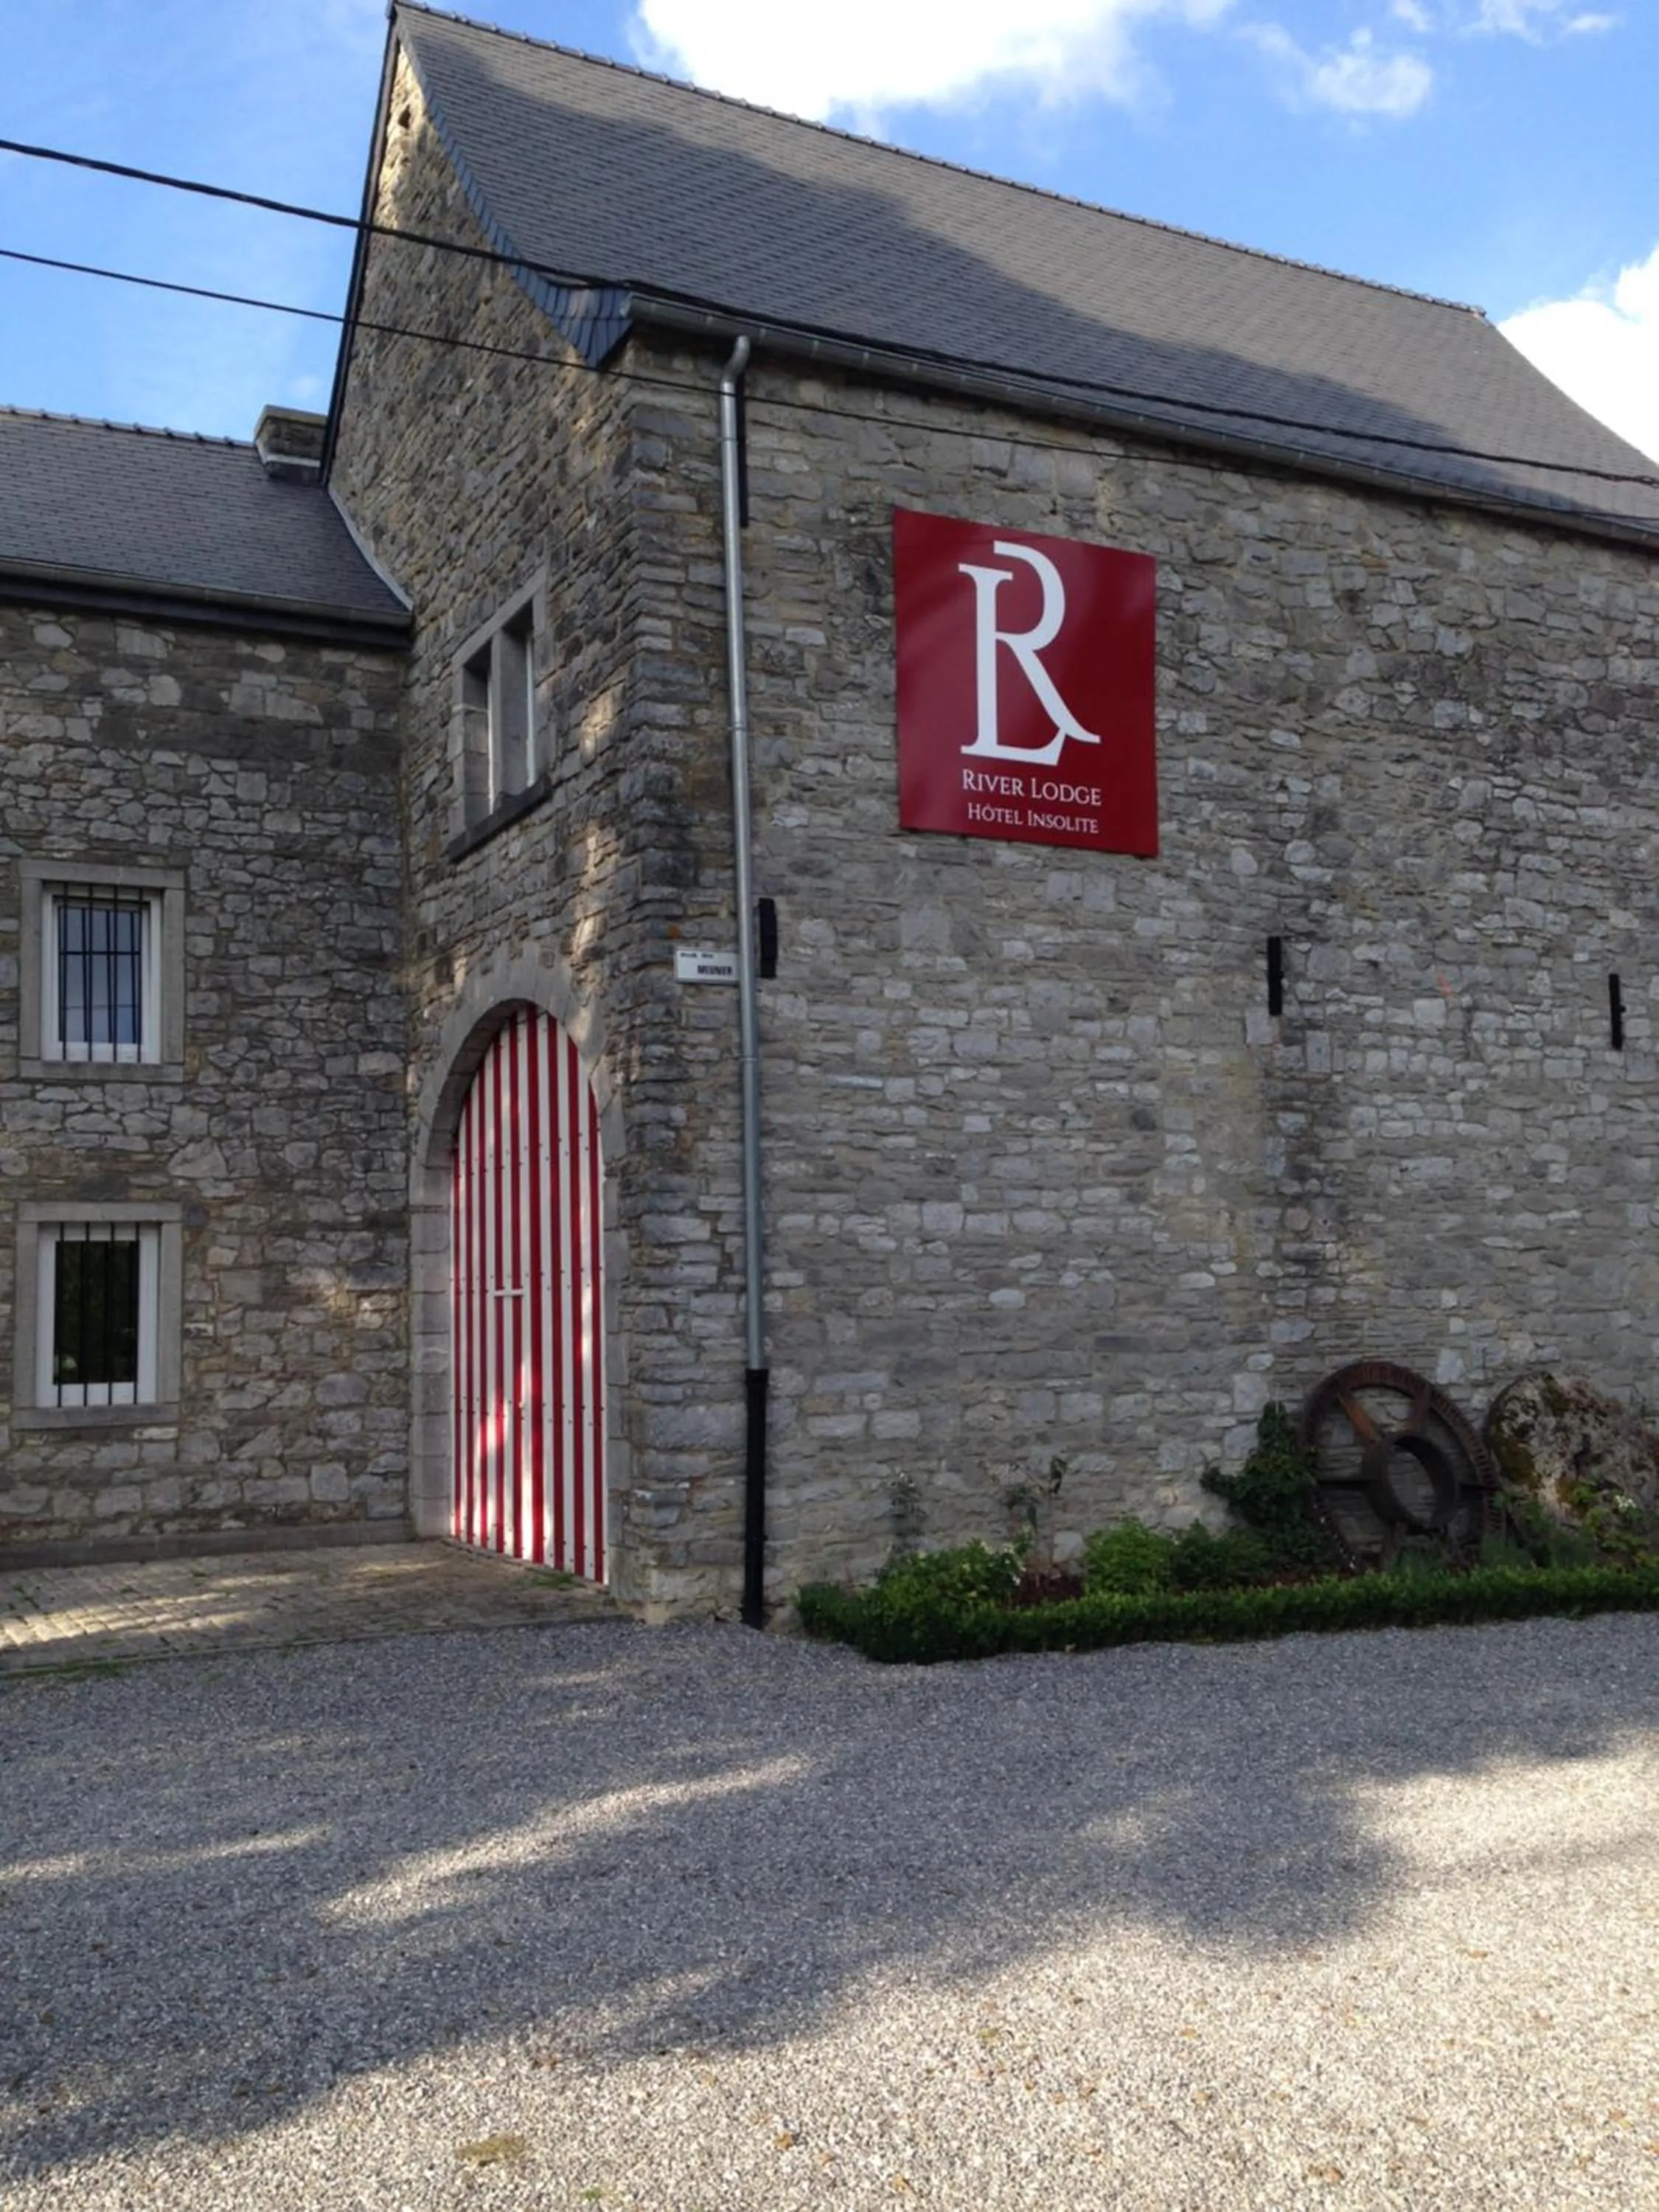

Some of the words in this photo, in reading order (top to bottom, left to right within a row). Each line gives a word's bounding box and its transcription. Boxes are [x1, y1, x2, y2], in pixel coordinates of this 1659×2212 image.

[962, 768, 1025, 798] RIVER
[1030, 777, 1102, 807] LODGE
[1027, 810, 1099, 834] INSOLITE
